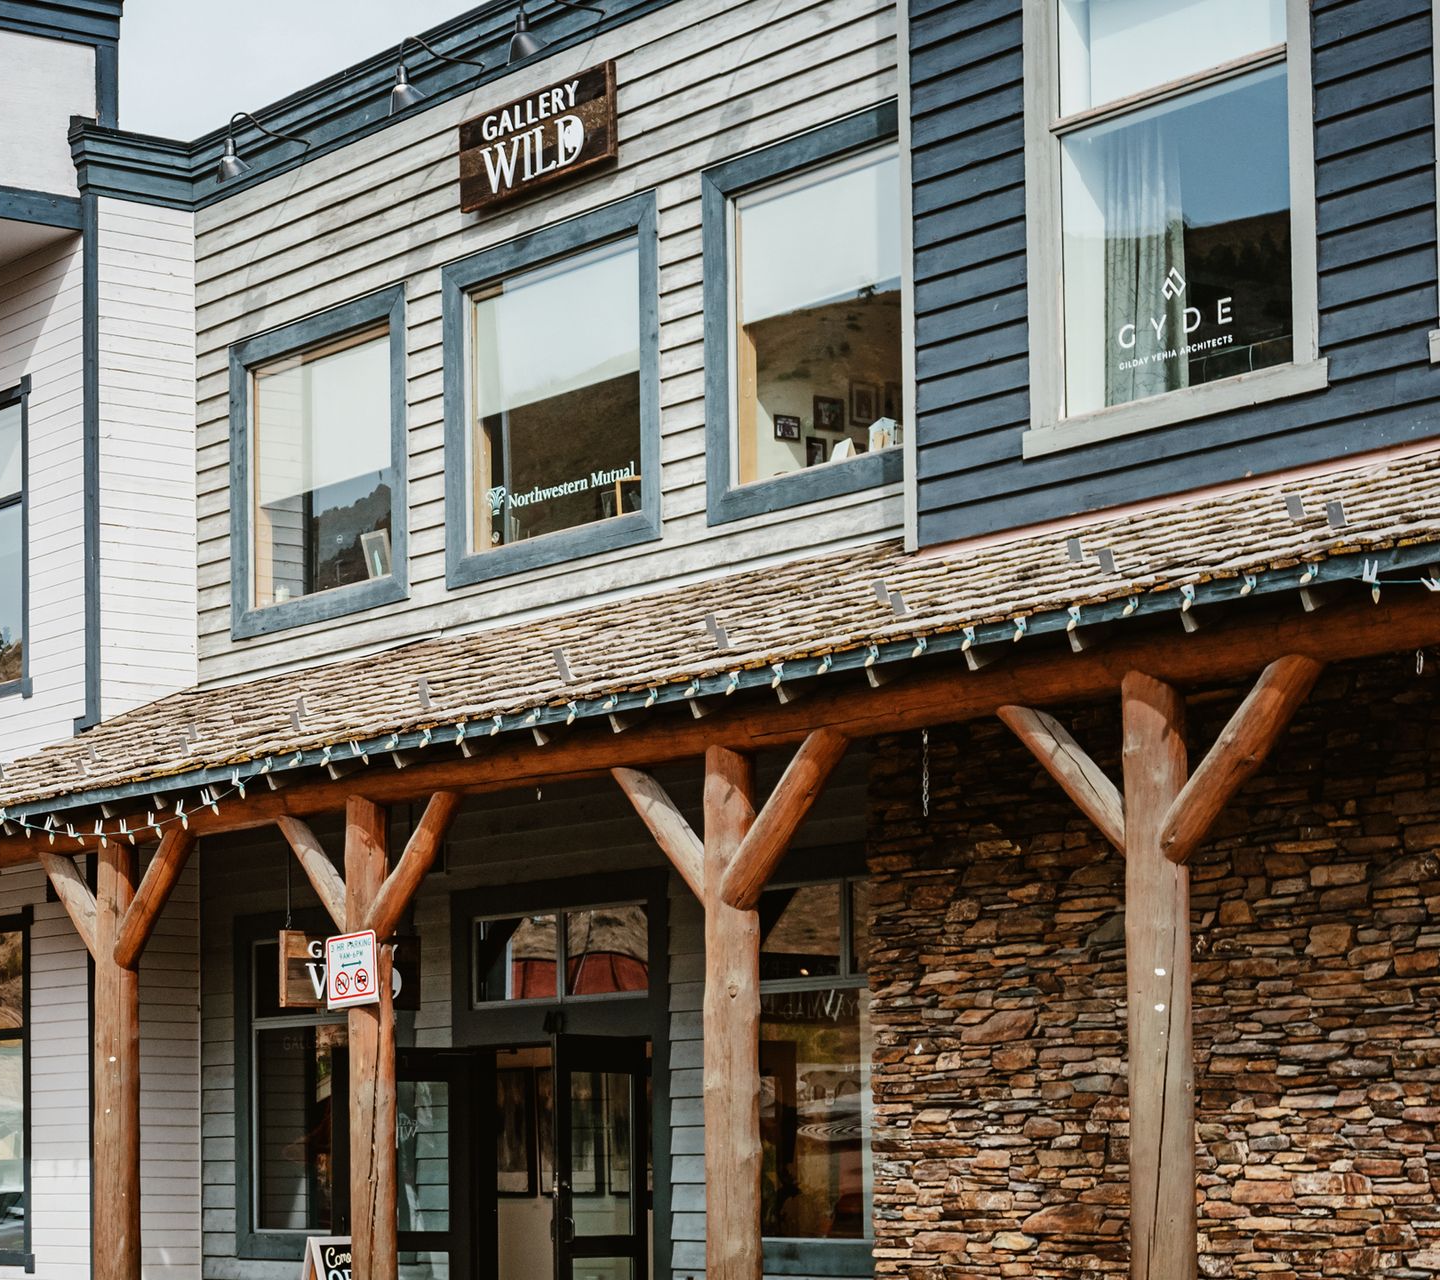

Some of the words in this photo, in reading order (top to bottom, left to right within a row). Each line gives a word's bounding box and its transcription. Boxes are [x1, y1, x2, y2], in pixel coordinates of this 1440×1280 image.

[482, 80, 579, 141] GALLERY
[480, 114, 585, 194] WILD
[1118, 296, 1233, 349] GYDE
[1119, 356, 1149, 370] GILDAY
[1152, 349, 1177, 361] YEHIA
[1180, 334, 1233, 355] ARCHITECTS
[508, 477, 588, 509] Northwestern
[591, 461, 635, 488] Mutual
[346, 938, 372, 950] PARKING
